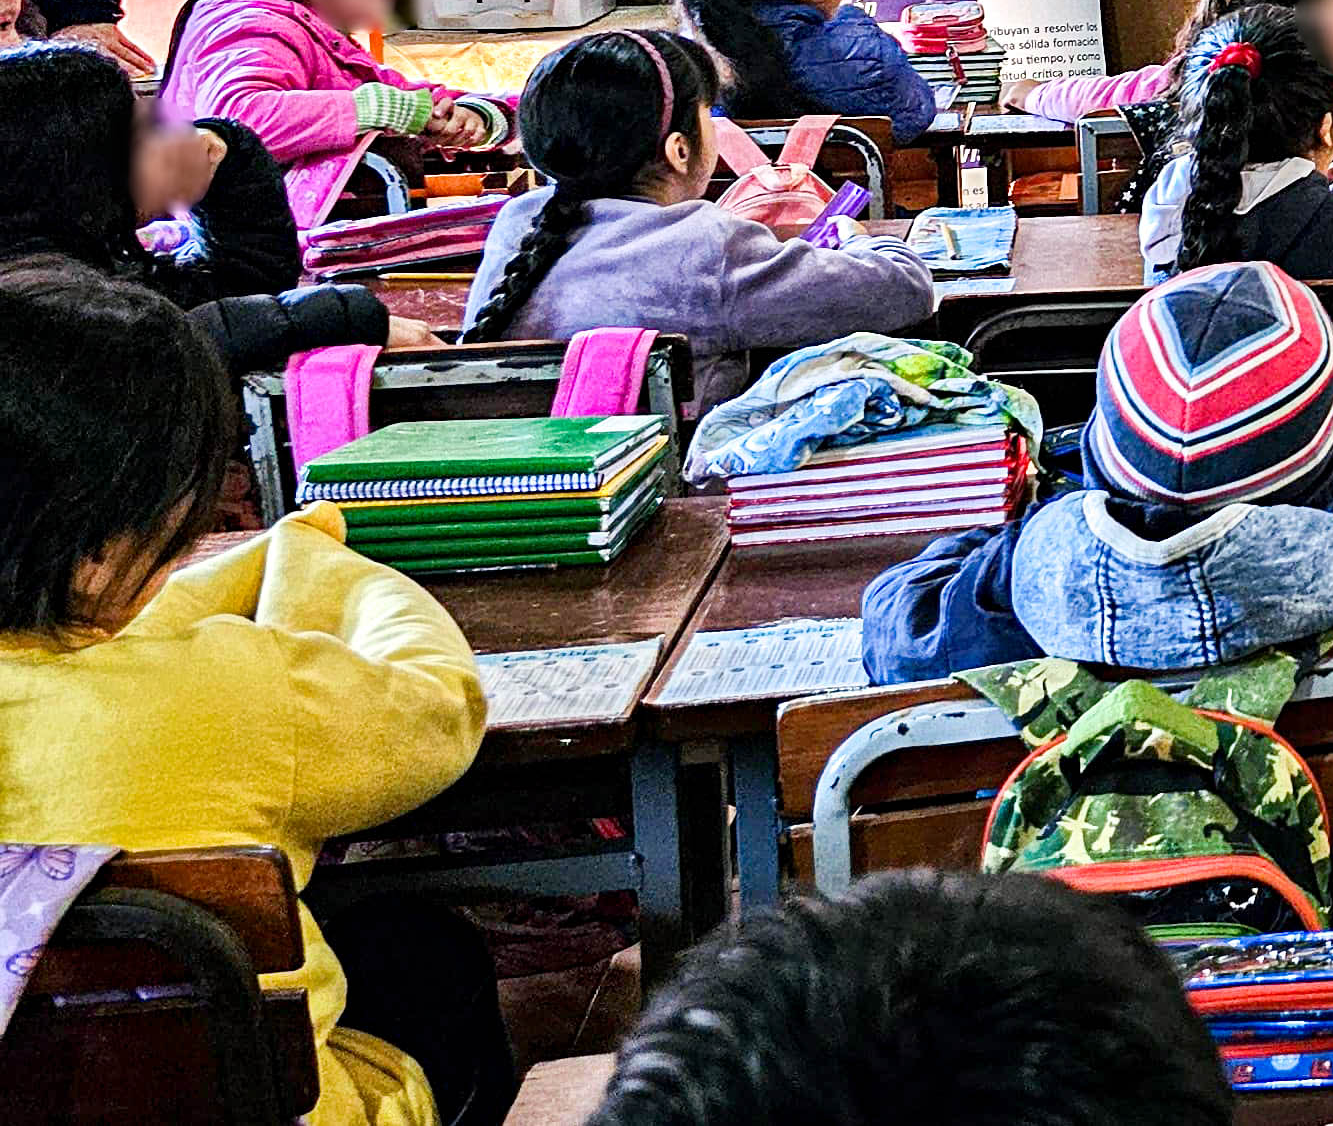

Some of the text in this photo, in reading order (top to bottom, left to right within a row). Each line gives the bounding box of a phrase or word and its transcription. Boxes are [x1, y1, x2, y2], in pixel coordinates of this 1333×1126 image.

[1045, 24, 1084, 33] resolver
[1019, 36, 1099, 50] sólida formación
[1011, 57, 1023, 65] su
[1026, 54, 1066, 66] tiempo,
[1032, 69, 1063, 79] crítica
